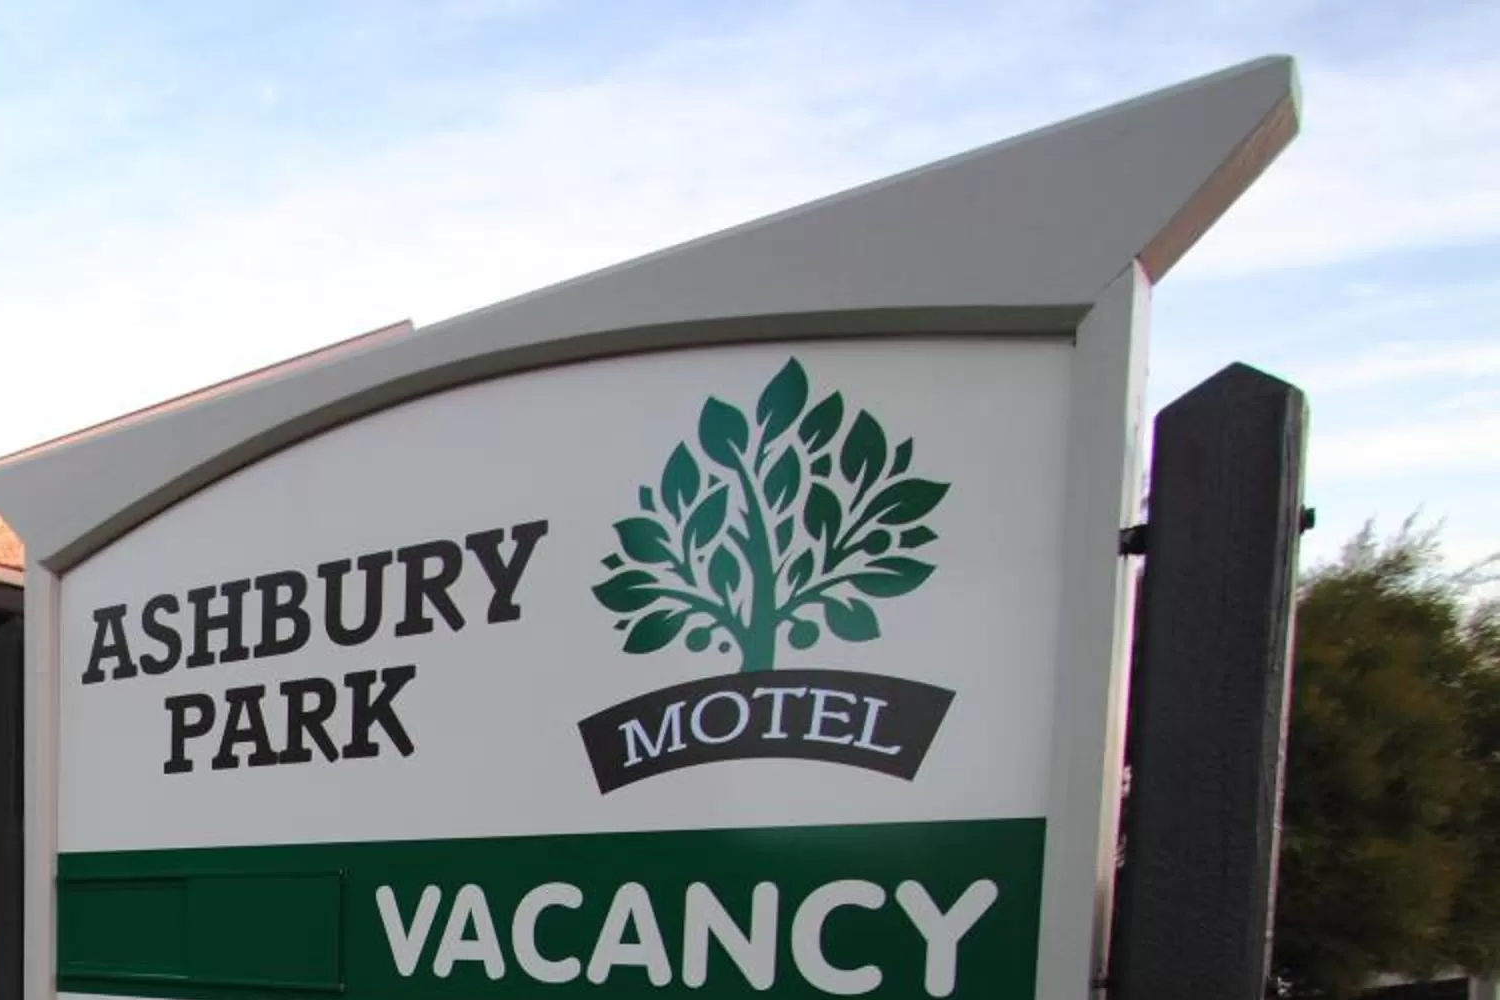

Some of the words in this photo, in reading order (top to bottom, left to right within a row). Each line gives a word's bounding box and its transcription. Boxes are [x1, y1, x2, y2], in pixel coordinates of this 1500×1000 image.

[81, 519, 549, 685] ASHBURY
[162, 664, 417, 775] PARK
[618, 686, 902, 767] MOTEL
[375, 879, 998, 998] VACANCY
